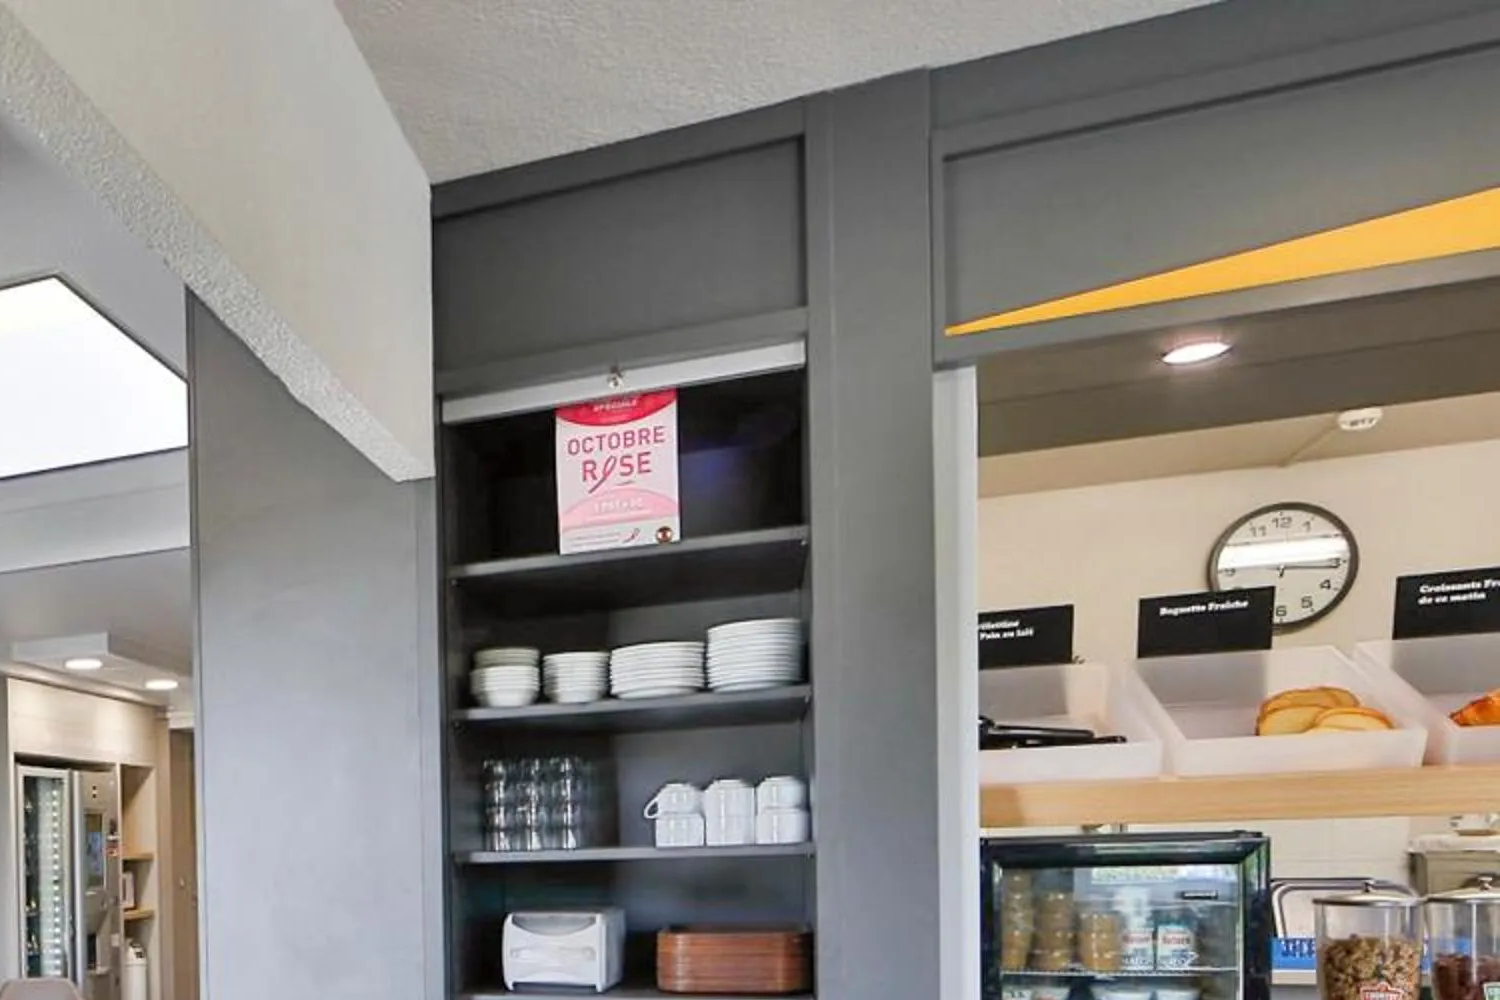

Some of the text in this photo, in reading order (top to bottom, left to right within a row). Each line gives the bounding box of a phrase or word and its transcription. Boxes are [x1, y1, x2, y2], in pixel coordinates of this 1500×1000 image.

[567, 425, 666, 456] OCTOBRE
[1271, 516, 1293, 529] 12
[1302, 521, 1312, 532] 1
[1250, 525, 1267, 537] 11
[1319, 579, 1332, 590] 4
[1301, 595, 1314, 609] 5
[1275, 605, 1288, 617] 6
